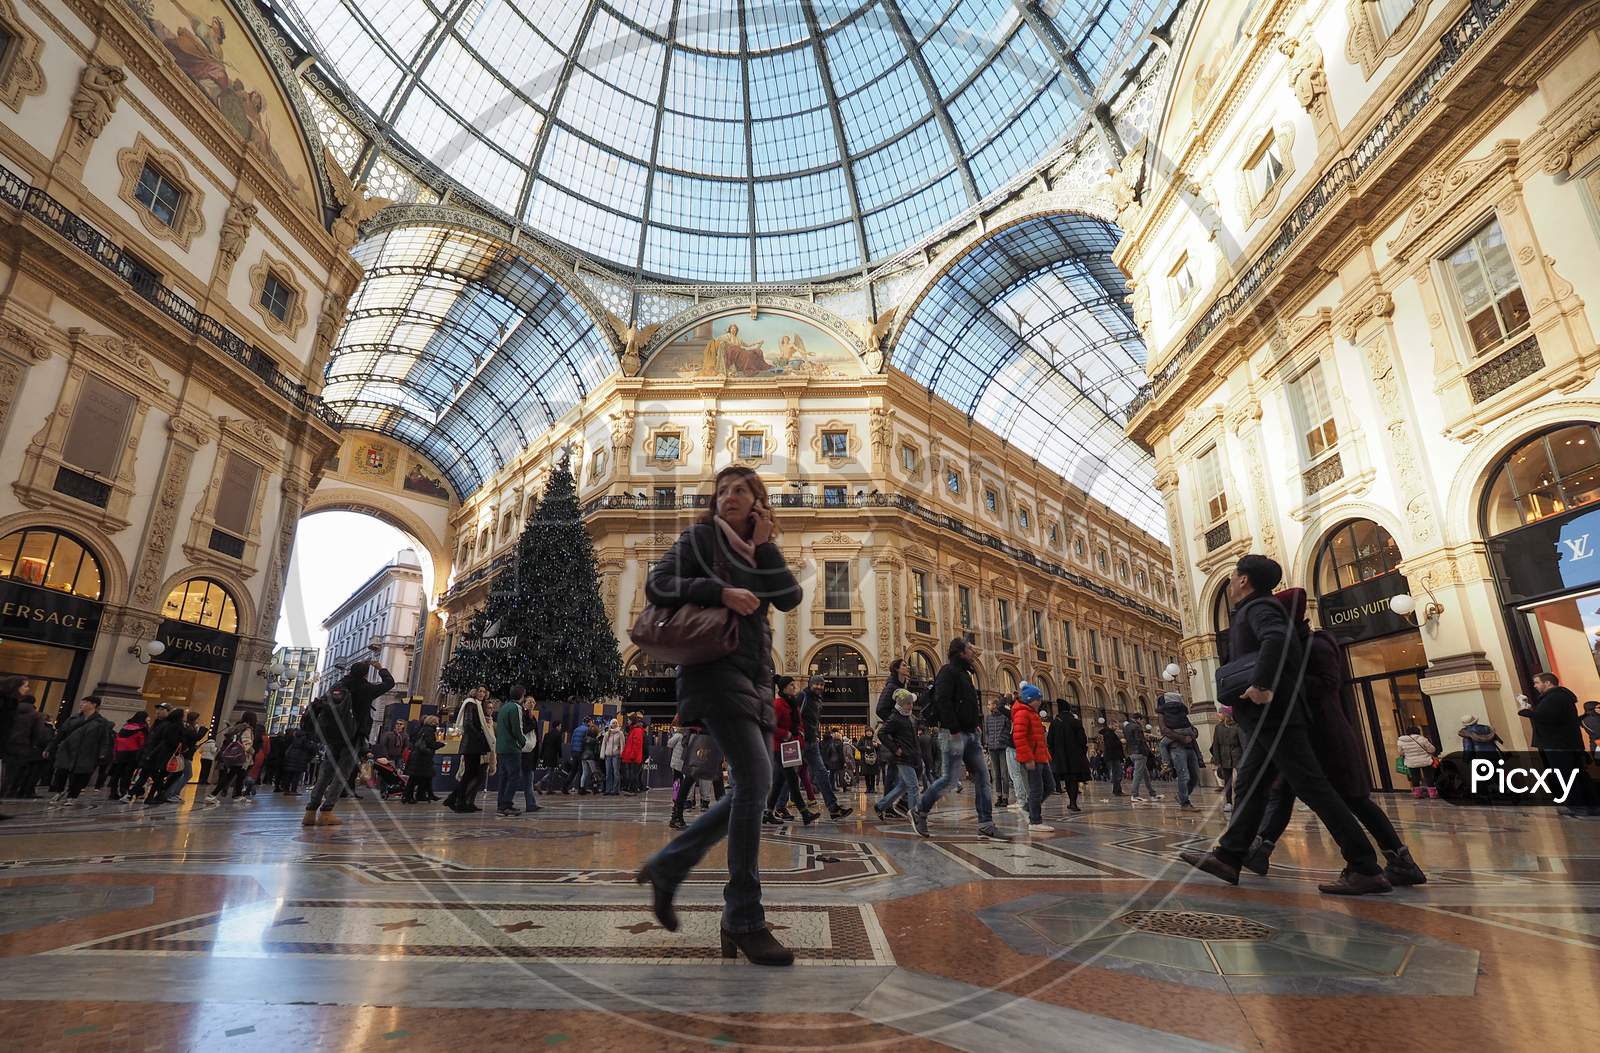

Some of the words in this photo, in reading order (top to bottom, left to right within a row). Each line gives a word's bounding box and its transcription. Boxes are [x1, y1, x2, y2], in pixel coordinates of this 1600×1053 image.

[1330, 607, 1360, 625] LOUIS
[166, 635, 229, 657] VERSACE
[461, 635, 517, 651] SWAROVSKI
